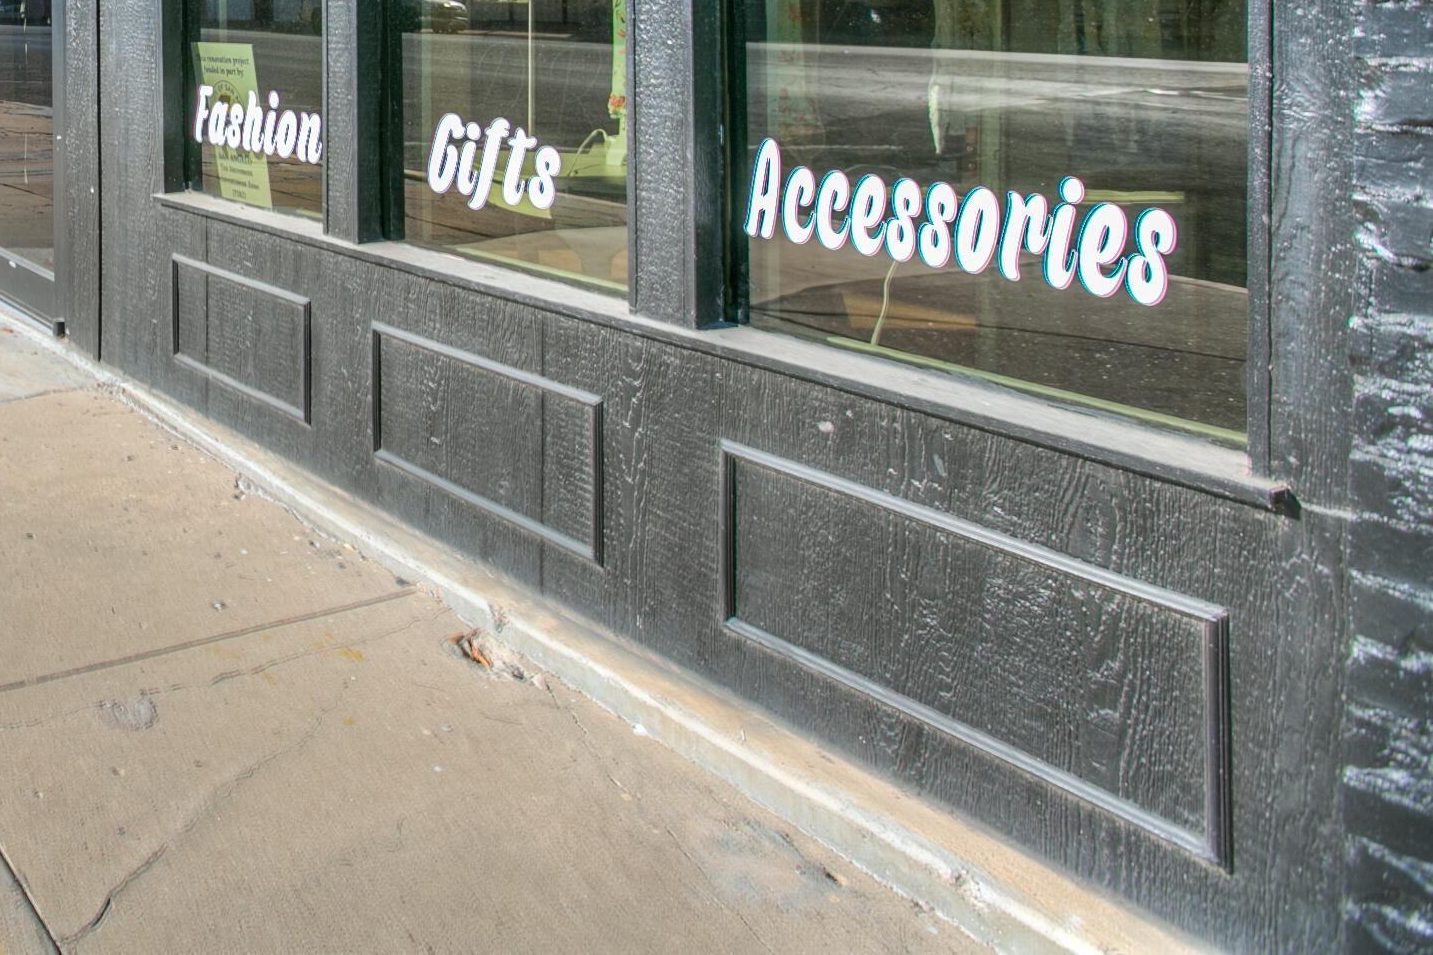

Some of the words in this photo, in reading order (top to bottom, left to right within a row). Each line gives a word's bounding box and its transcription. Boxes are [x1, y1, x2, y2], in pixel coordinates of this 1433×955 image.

[194, 84, 322, 164] Fashion
[426, 112, 561, 210] Gifts
[743, 137, 1178, 307] Accessories
